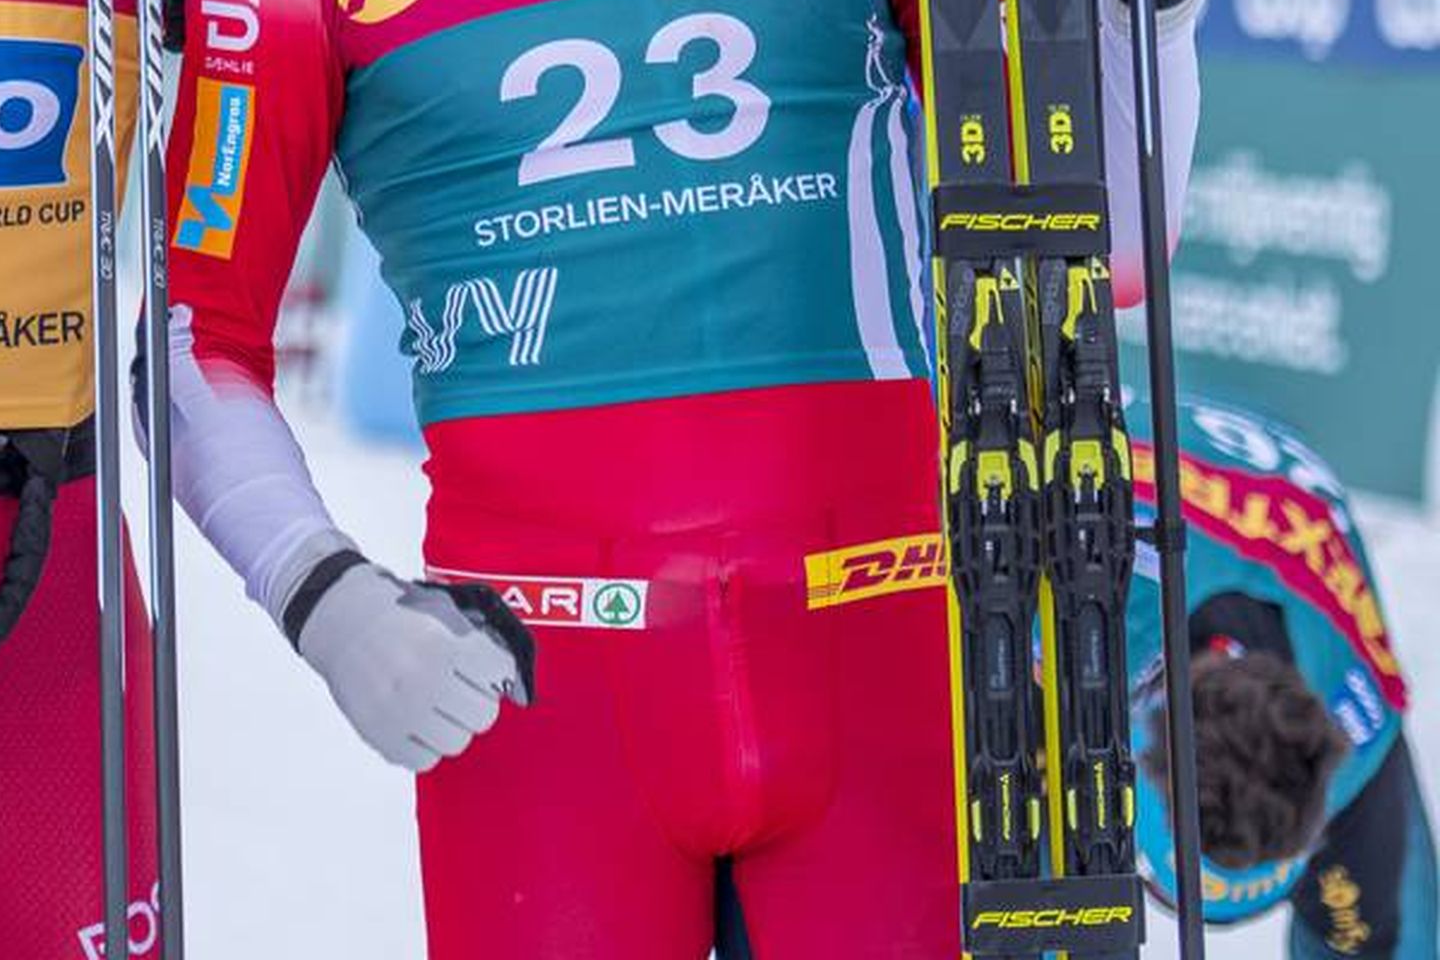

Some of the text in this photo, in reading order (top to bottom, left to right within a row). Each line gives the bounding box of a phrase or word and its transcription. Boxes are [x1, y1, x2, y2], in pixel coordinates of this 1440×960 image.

[499, 12, 773, 187] 23
[961, 120, 986, 164] 3D
[1048, 111, 1075, 155] 3D
[39, 200, 86, 223] CUP
[473, 171, 838, 248] STORLIEN-MERÅKER
[939, 212, 1102, 231] FISCHER
[841, 539, 947, 593] DH
[501, 586, 579, 616] AR
[971, 906, 1133, 930] FISCHER
